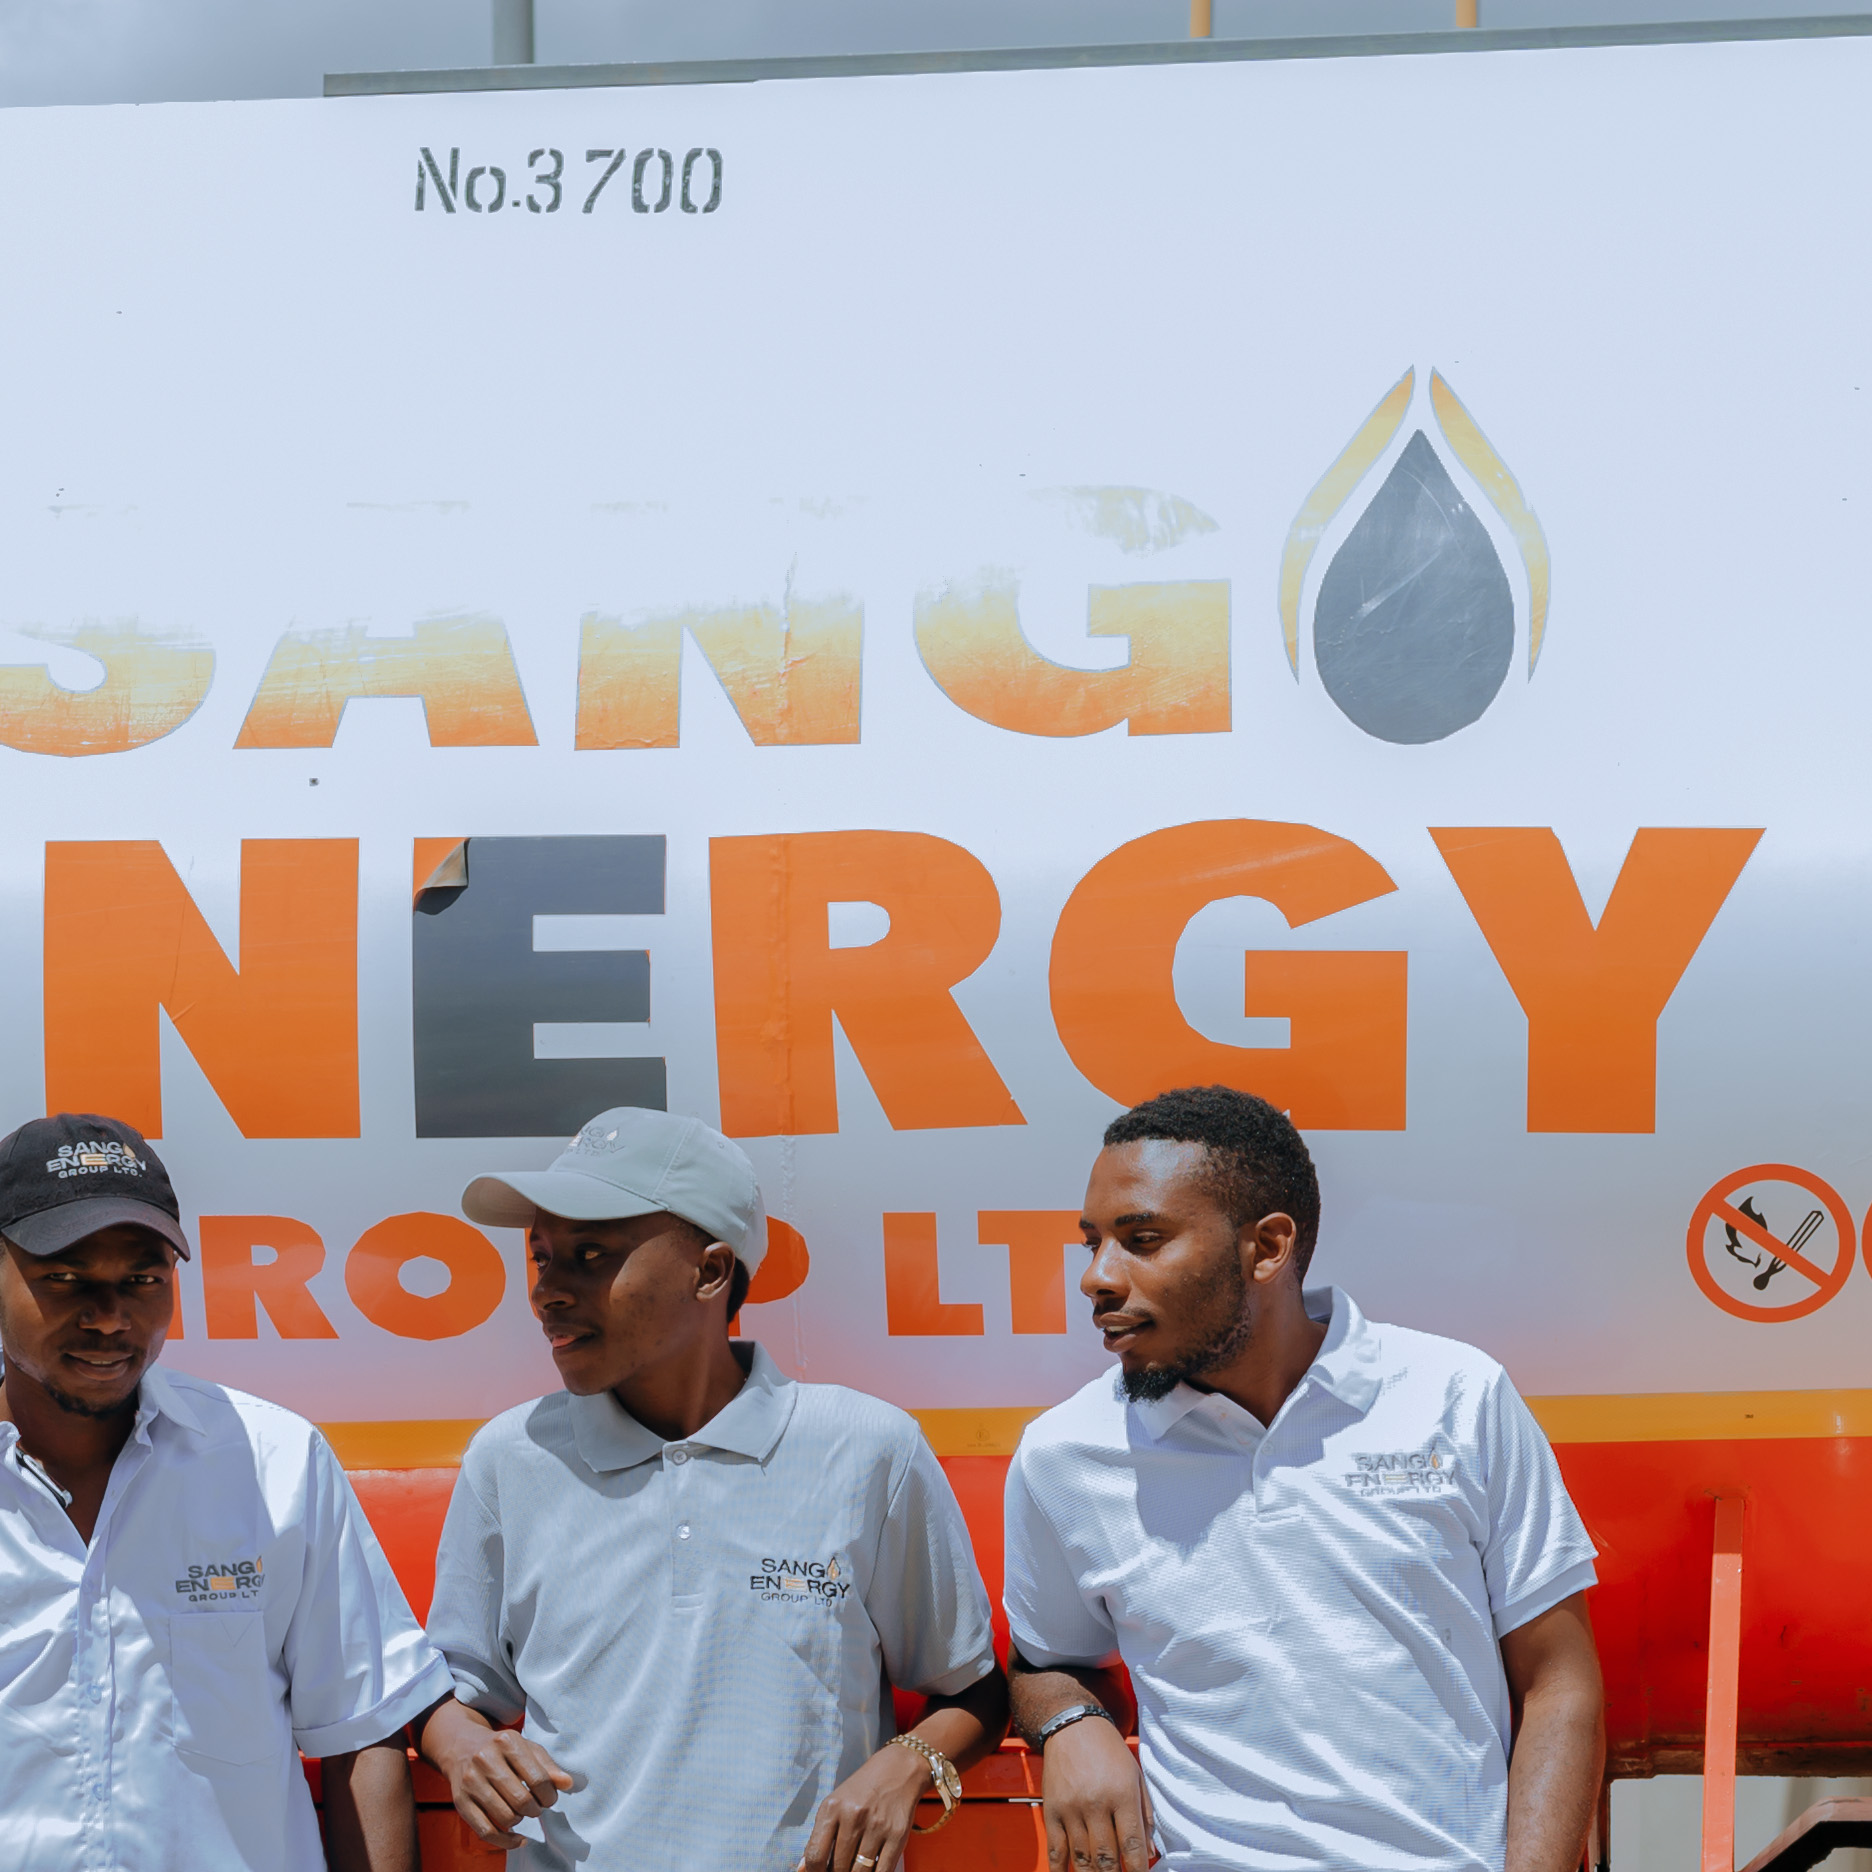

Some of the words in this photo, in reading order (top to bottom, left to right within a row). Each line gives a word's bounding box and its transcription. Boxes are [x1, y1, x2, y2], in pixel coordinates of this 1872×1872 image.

[414, 146, 724, 214] No.3700
[46, 1154, 147, 1174] ENERGY
[58, 1165, 108, 1179] GROUP
[882, 1210, 1081, 1338] LT
[188, 1592, 237, 1602] GROUP
[750, 1575, 850, 1599] ENERGY
[761, 1592, 809, 1604] GROUP
[815, 1597, 833, 1608] LTD
